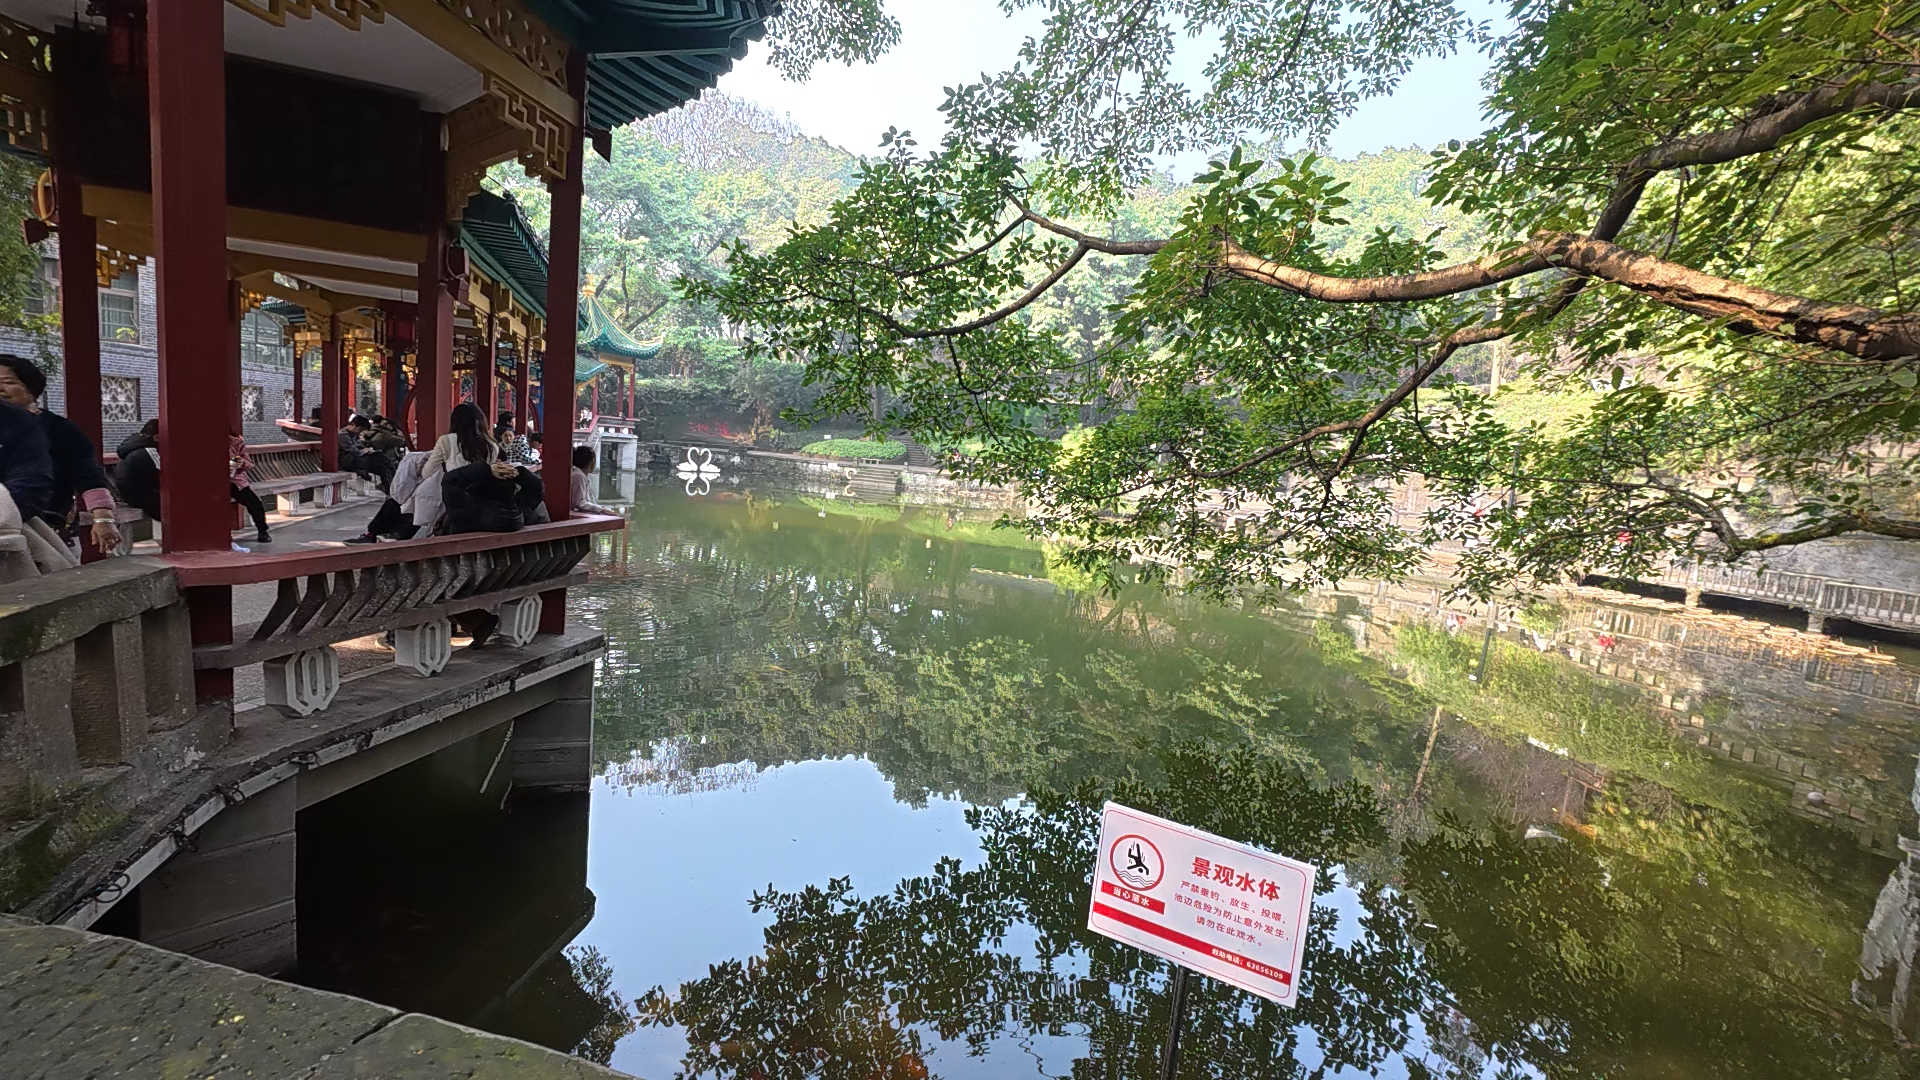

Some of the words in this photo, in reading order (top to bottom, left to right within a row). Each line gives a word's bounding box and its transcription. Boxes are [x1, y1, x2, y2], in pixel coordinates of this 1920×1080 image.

[1192, 857, 1281, 901] 景观水体
[1113, 887, 1149, 906] 当心落水
